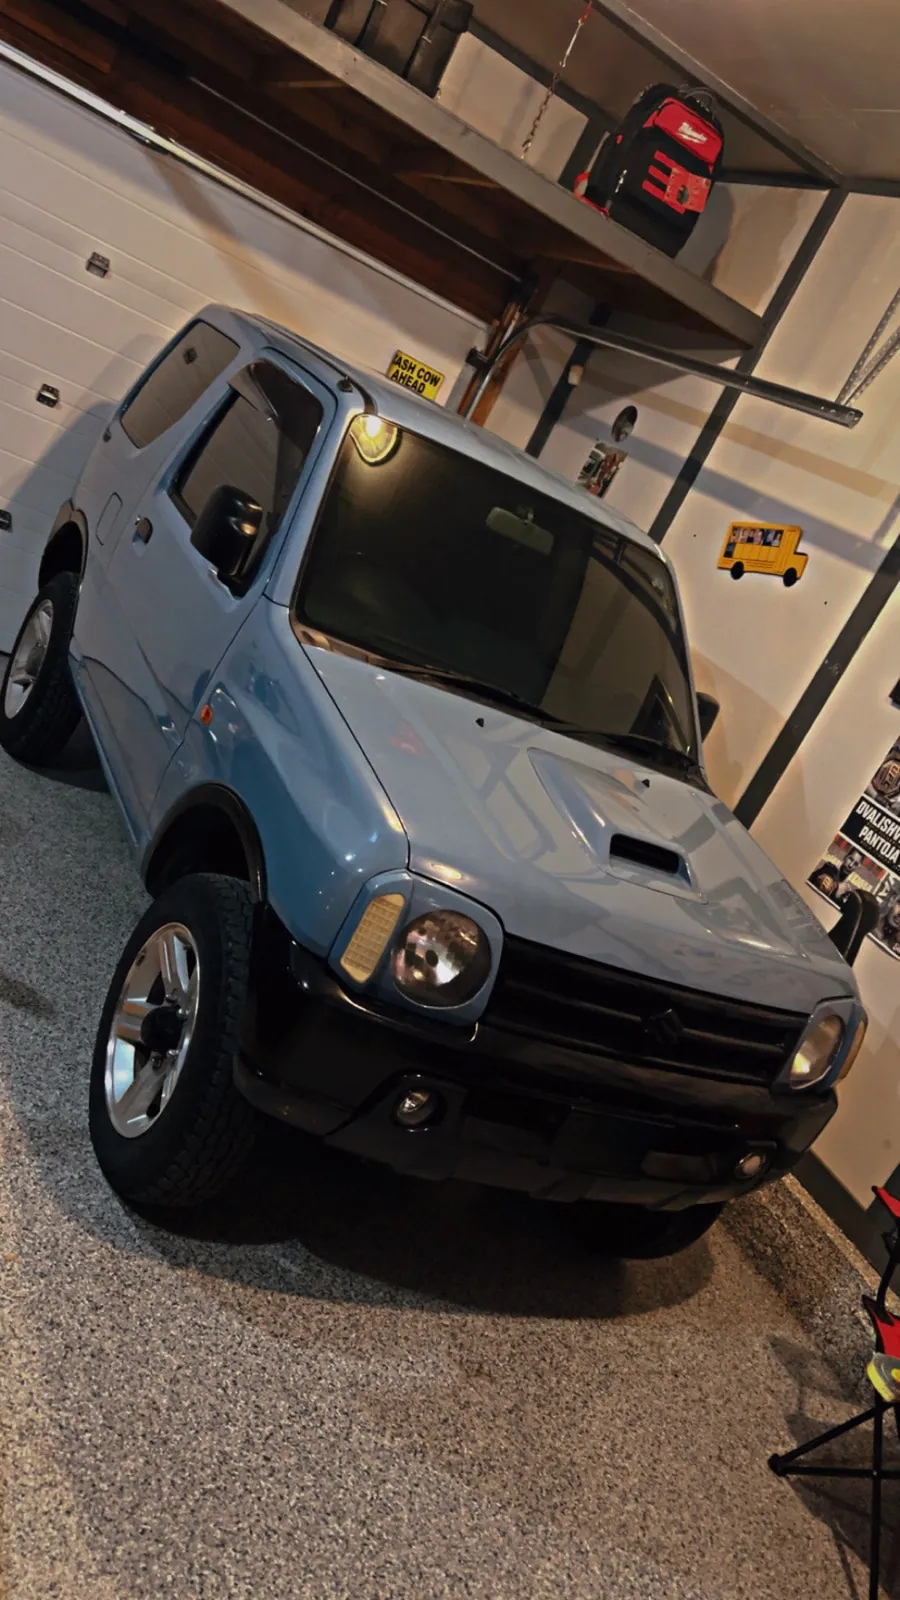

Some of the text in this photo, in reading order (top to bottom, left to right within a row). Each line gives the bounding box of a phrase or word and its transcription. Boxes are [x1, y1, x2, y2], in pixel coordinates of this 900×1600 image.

[390, 369, 426, 394] AHEAD
[417, 368, 441, 387] COW
[856, 801, 900, 844] DVALISHV
[858, 825, 900, 863] PANTOJA
